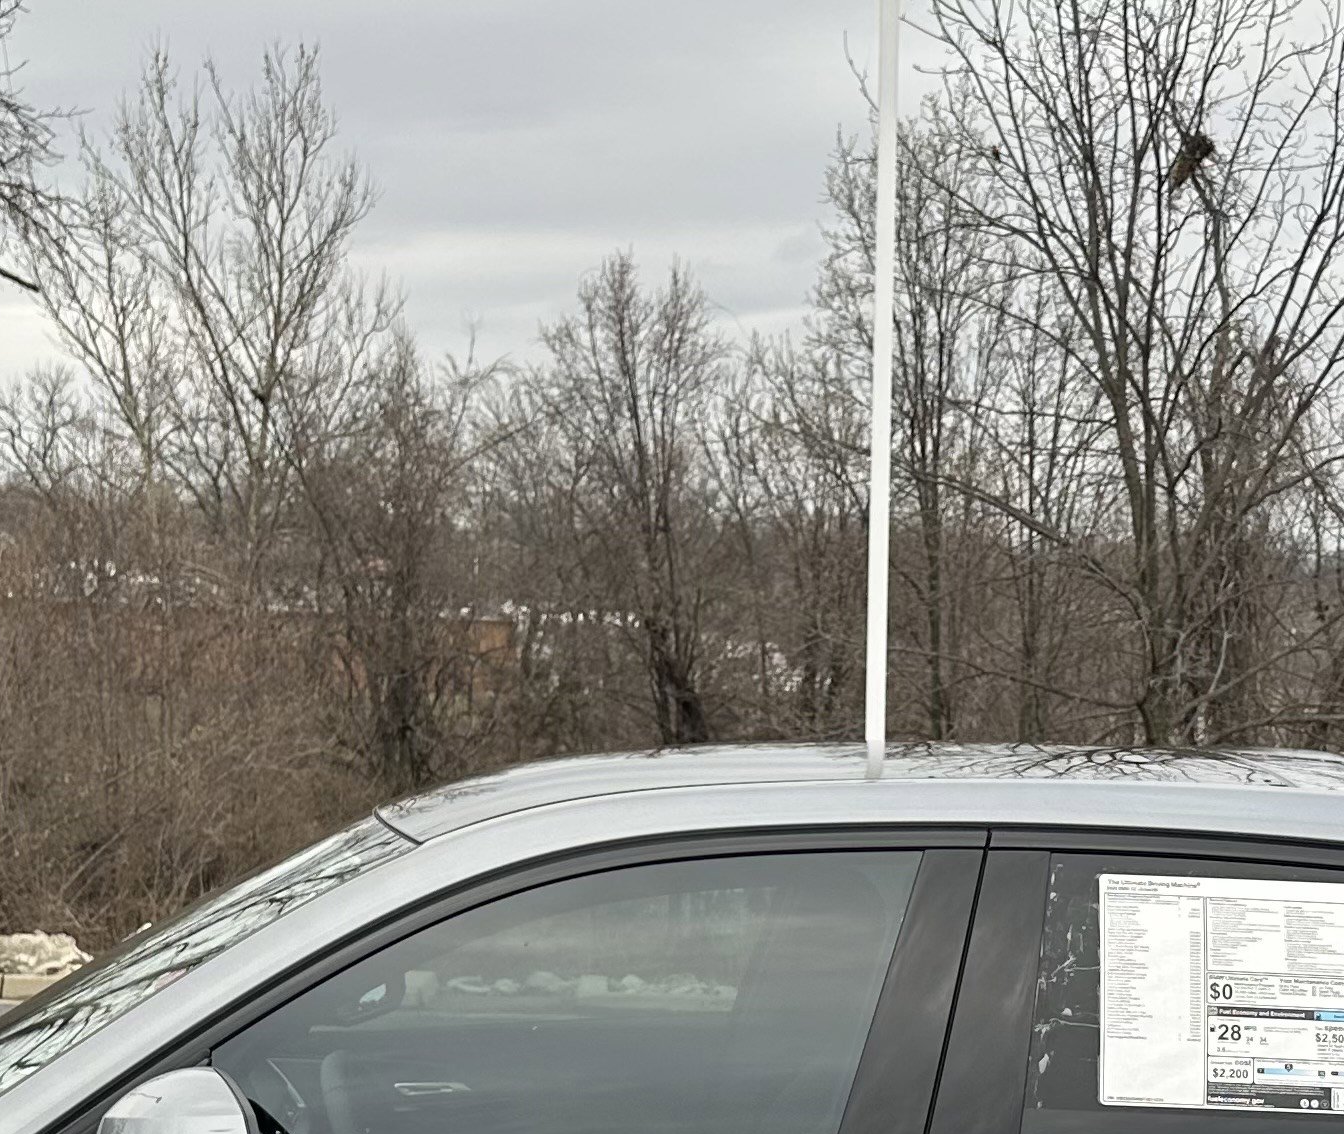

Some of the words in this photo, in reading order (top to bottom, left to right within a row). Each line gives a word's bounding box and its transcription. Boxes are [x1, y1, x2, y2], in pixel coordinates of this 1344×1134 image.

[1209, 982, 1233, 1000] $0
[1217, 1023, 1242, 1041] 28
[1212, 1067, 1249, 1080] $2,200
